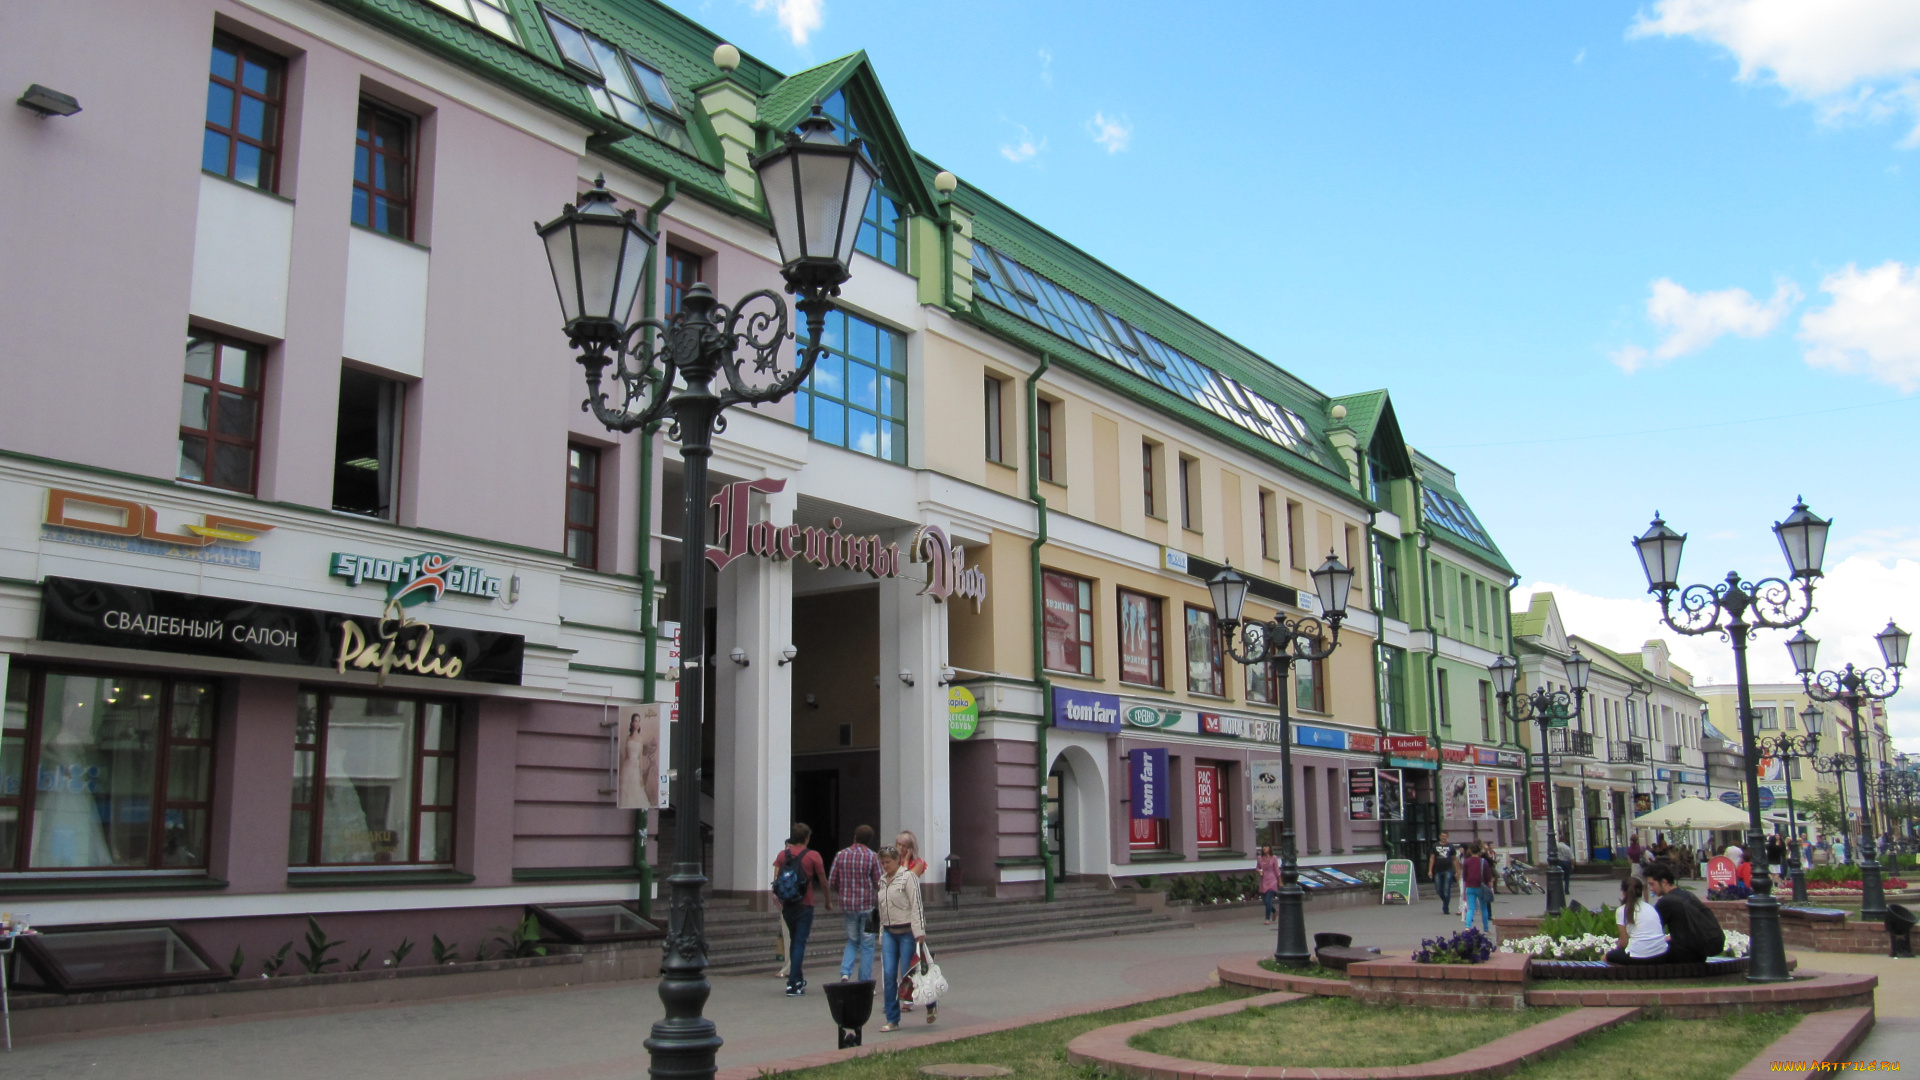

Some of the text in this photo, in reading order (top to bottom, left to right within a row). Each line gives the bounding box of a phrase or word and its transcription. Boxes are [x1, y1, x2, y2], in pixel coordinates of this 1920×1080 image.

[165, 547, 250, 566] ДЖИНС
[705, 477, 986, 614] Гасціны Двор
[337, 553, 501, 597] sport elite
[104, 610, 297, 647] СВАДЕБНЫЙ САЛОН
[336, 620, 463, 687] Papilio
[1093, 701, 1116, 724] farr
[950, 722, 971, 730] ОБУВЬ
[1397, 739, 1423, 748] faberlic
[1140, 752, 1153, 782] farr
[1198, 771, 1211, 784] РАС
[1198, 784, 1212, 796] ПРО
